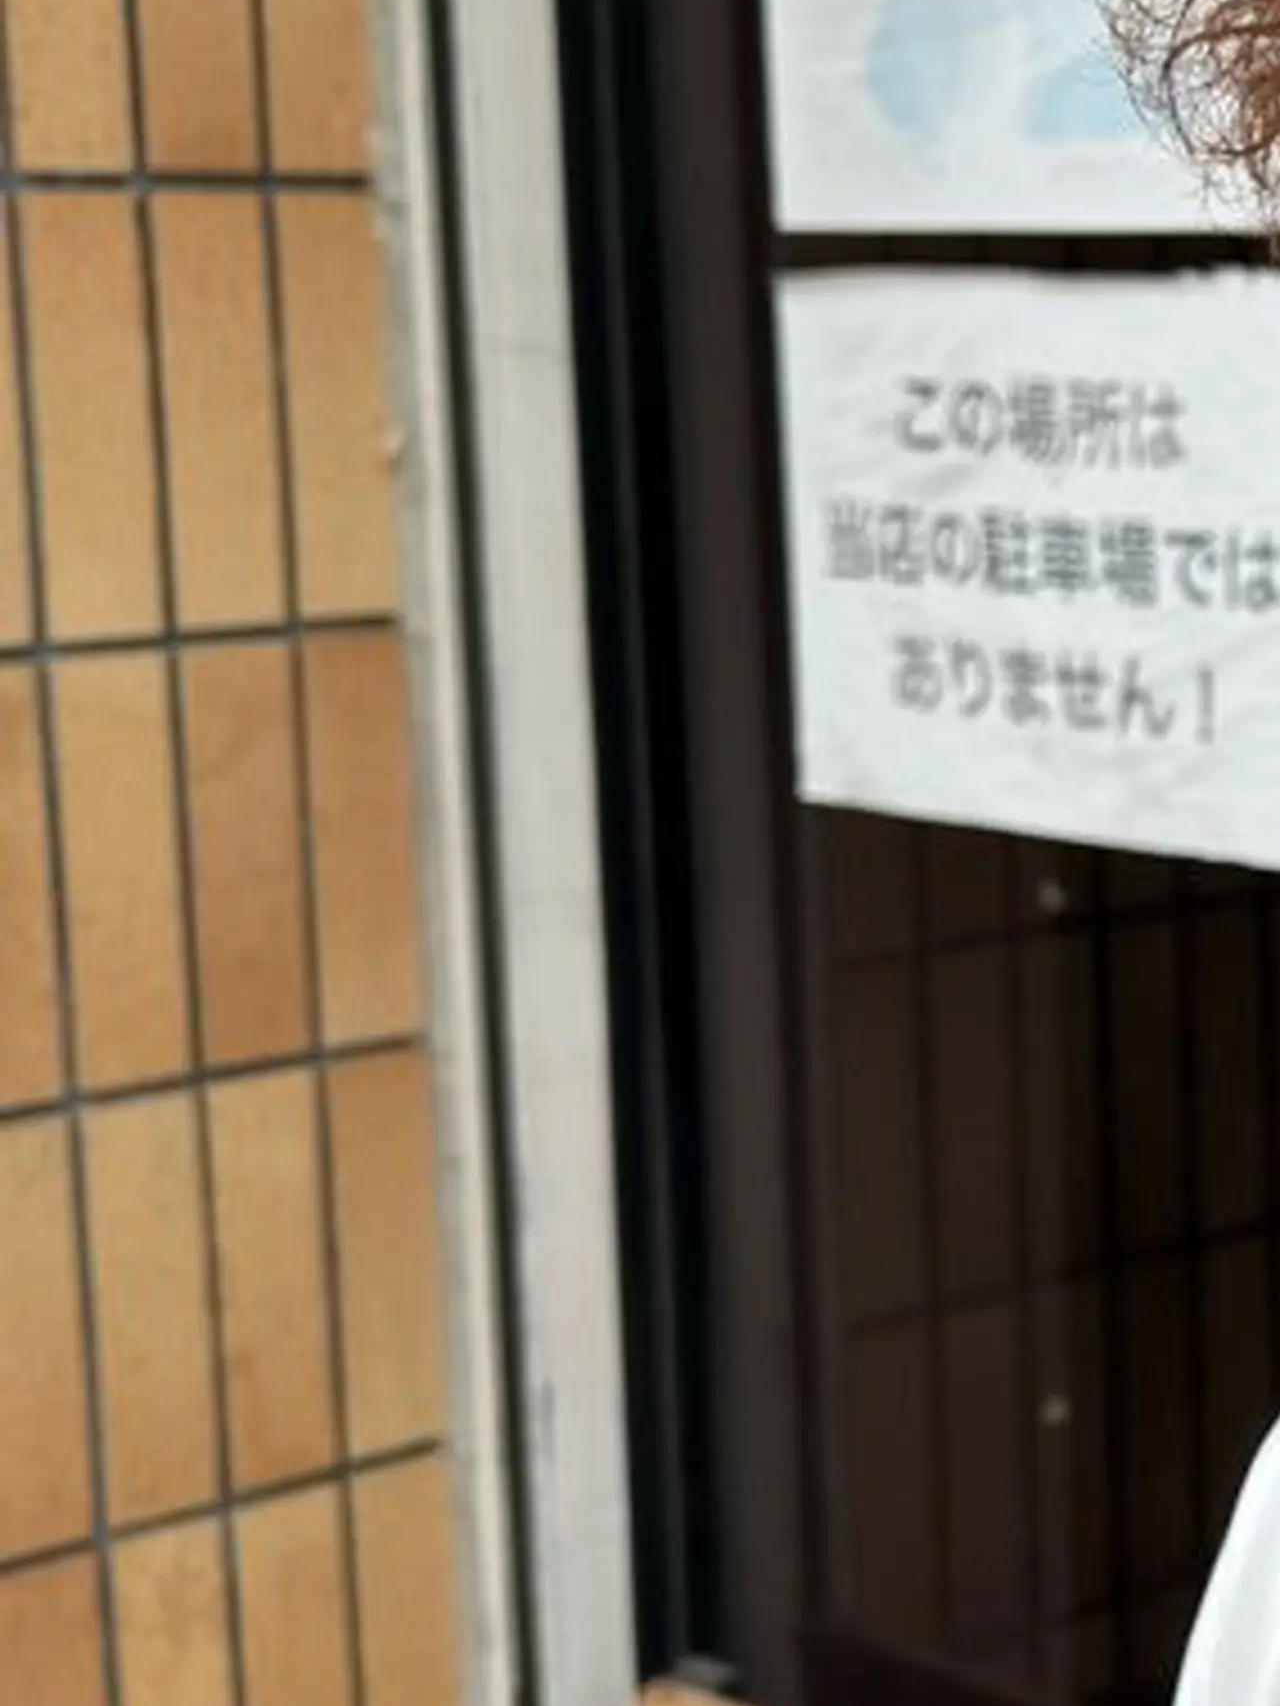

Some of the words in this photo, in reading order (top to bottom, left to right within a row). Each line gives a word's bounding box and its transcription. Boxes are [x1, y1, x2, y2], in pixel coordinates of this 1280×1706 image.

[894, 374, 1190, 470] この場所は
